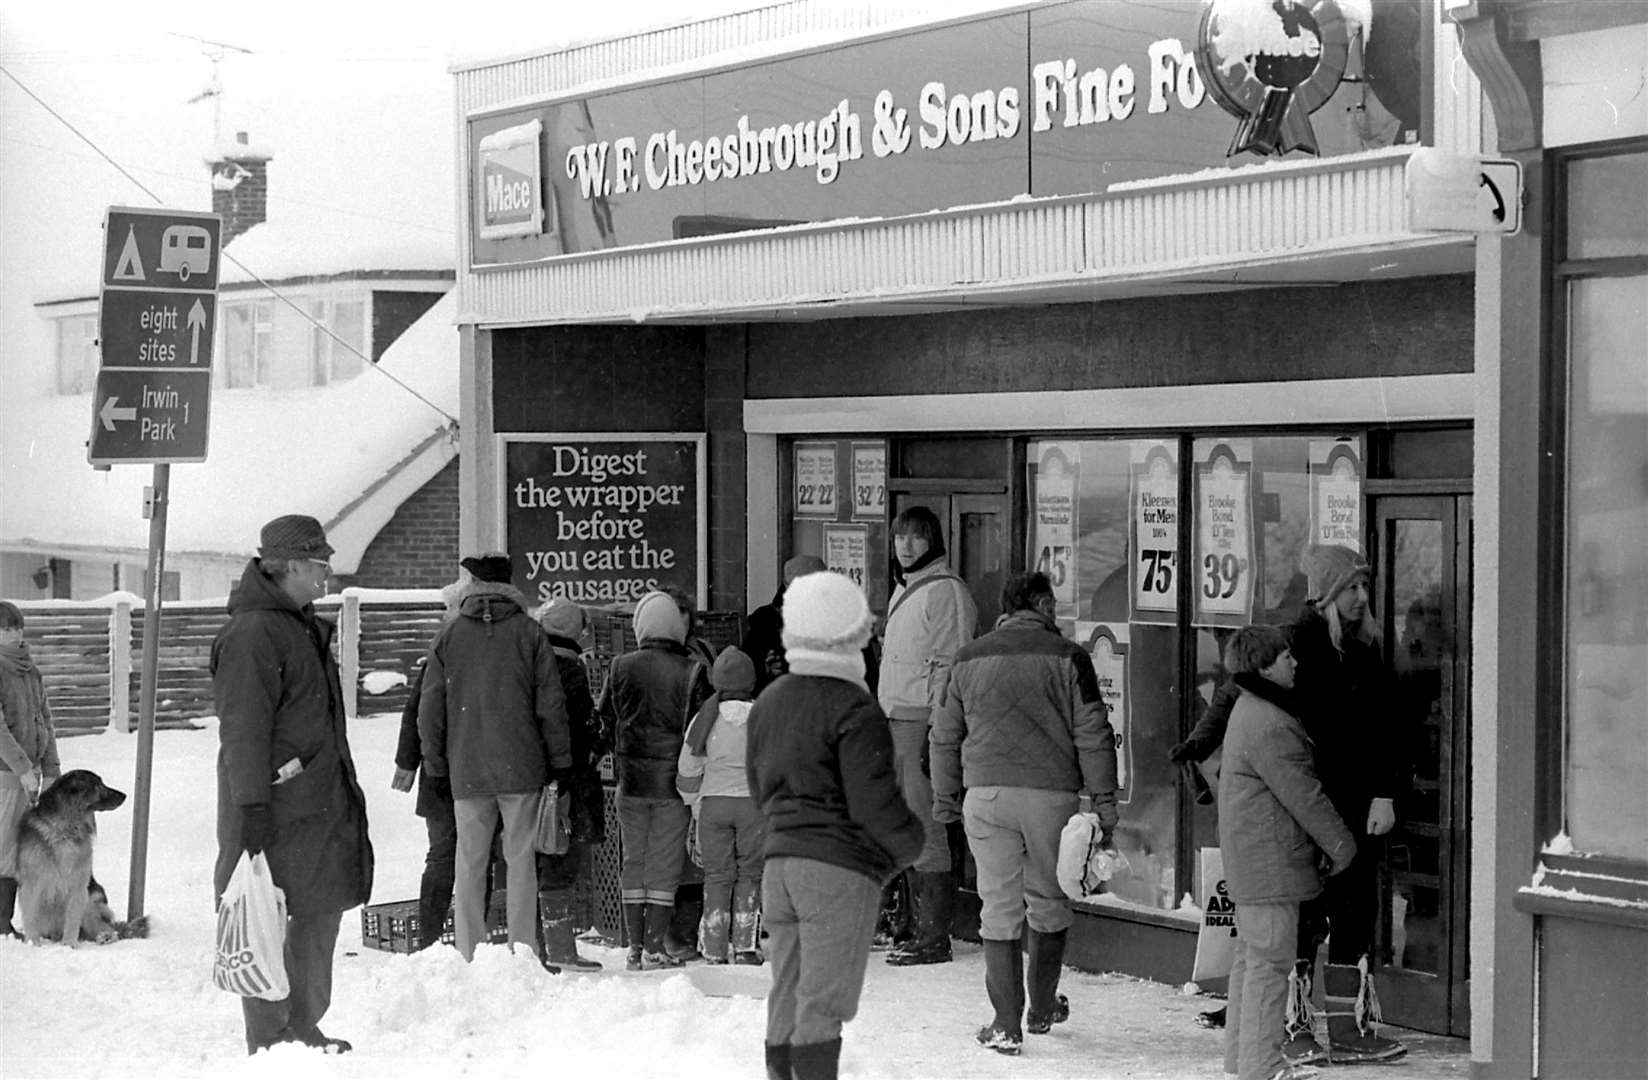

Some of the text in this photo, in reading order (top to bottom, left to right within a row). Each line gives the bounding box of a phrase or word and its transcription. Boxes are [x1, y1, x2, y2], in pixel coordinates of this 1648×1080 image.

[644, 98, 864, 191] Cheesbrough
[872, 89, 912, 158] &
[919, 82, 1021, 150] Sons
[1032, 57, 1136, 132] Fine
[1147, 38, 1207, 115] Fo
[487, 174, 531, 213] Mace
[140, 305, 178, 334] eight
[138, 338, 176, 362] sites
[141, 385, 179, 409] Irwin
[183, 402, 190, 424] 1
[140, 417, 176, 441] Park
[552, 446, 647, 483] Digest
[514, 478, 685, 513] the wrapper
[556, 510, 644, 540] before
[1144, 508, 1156, 525] for
[526, 540, 676, 580] you eat the
[538, 578, 658, 604] sausages
